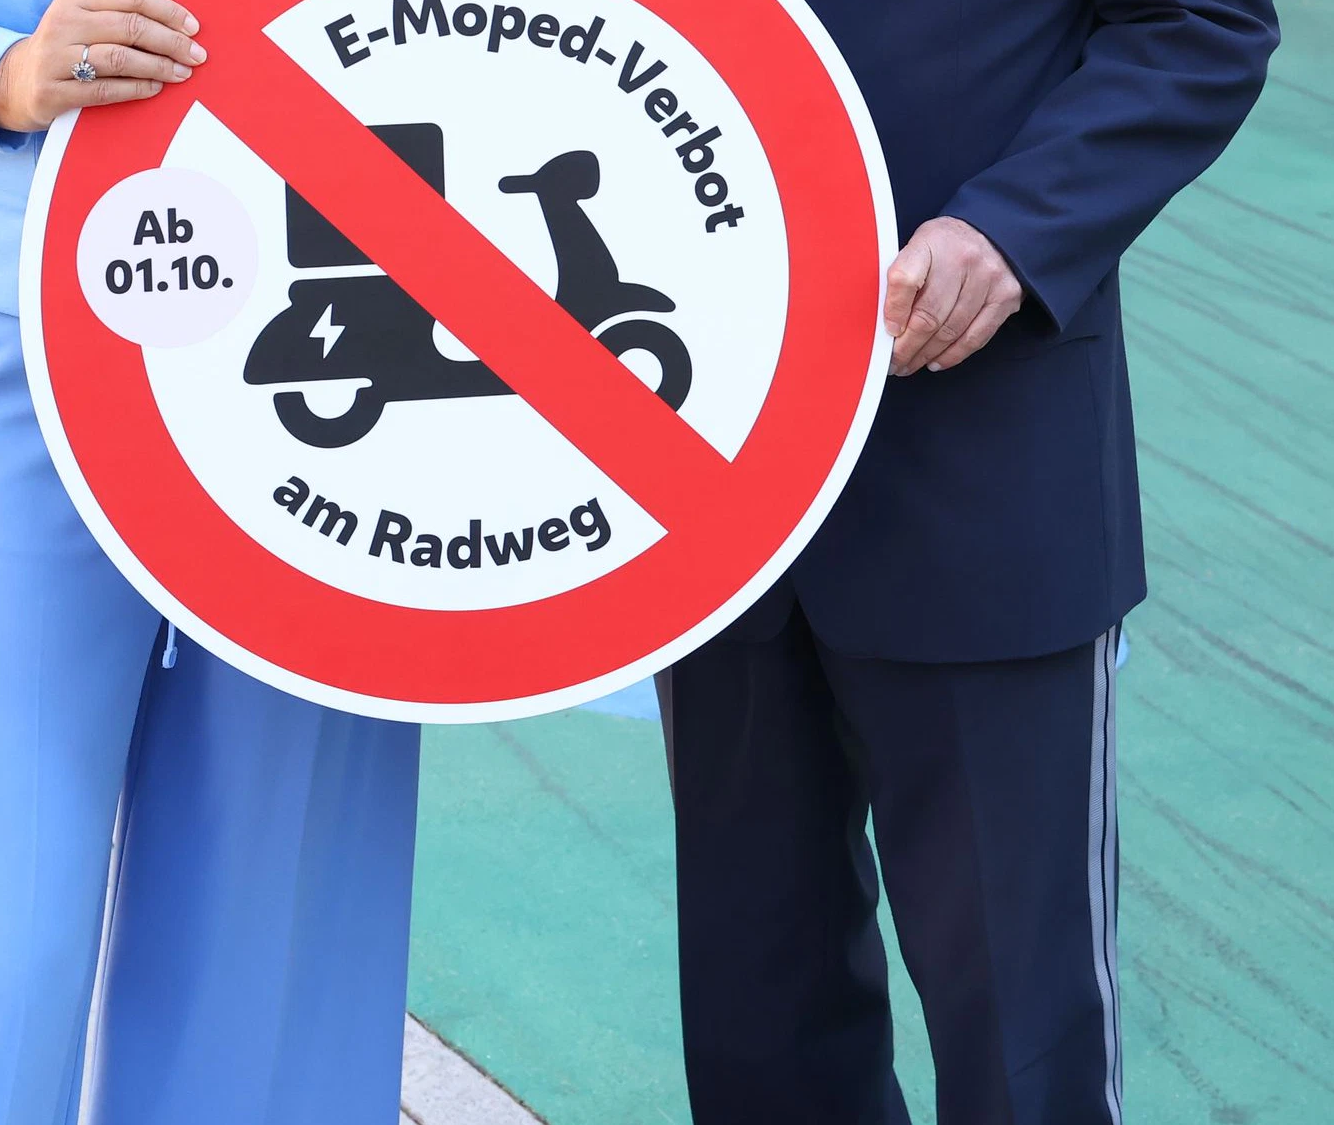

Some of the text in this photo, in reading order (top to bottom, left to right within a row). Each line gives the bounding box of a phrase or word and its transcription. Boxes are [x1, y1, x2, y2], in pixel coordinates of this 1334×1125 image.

[133, 207, 194, 246] Ab
[105, 254, 234, 295] 01.10.
[272, 475, 612, 570] am Radweg
